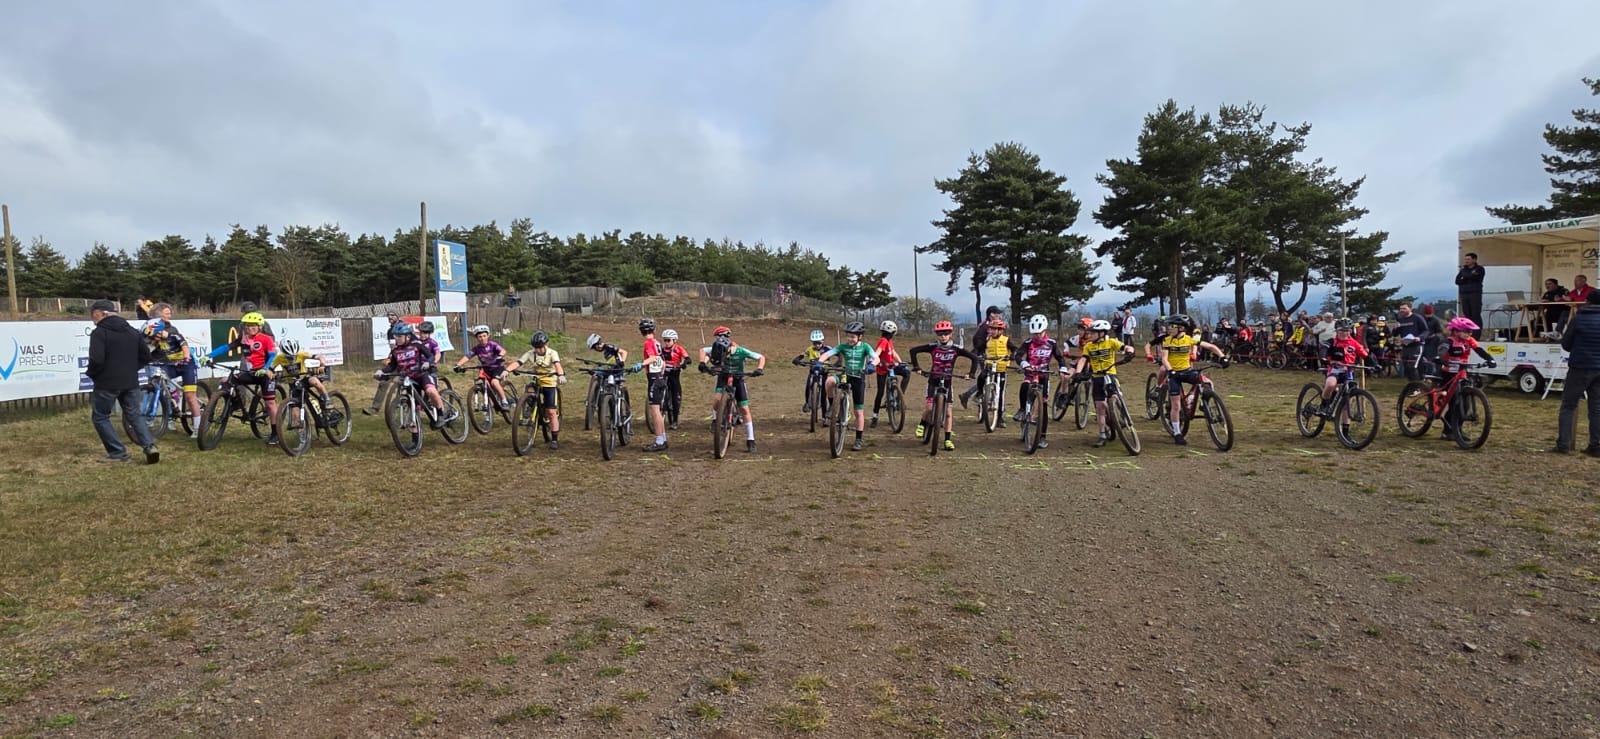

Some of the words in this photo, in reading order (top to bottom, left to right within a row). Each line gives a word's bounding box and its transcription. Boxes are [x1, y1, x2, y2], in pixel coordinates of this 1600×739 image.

[1498, 225, 1522, 234] CLUB
[1527, 224, 1542, 232] DU
[1547, 219, 1582, 229] VELAY
[19, 345, 45, 355] VALS
[58, 353, 75, 364] PUY
